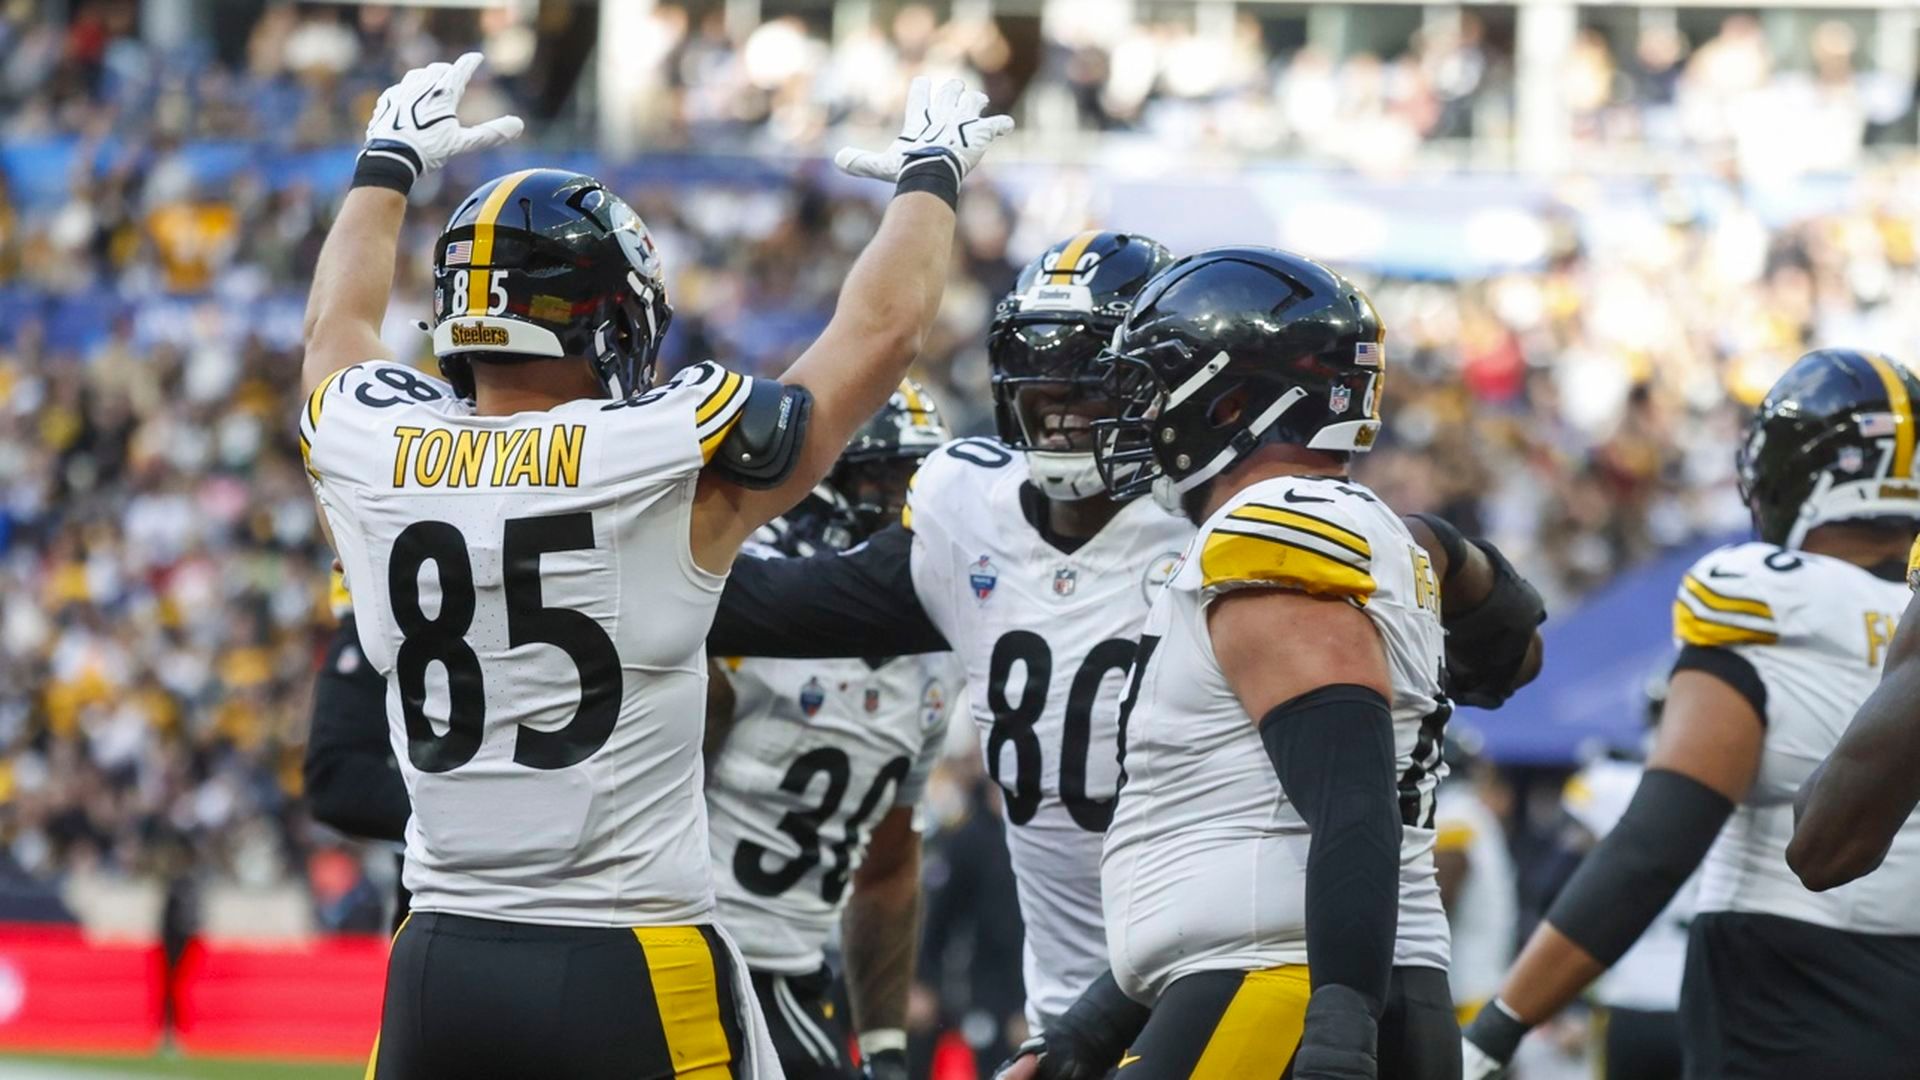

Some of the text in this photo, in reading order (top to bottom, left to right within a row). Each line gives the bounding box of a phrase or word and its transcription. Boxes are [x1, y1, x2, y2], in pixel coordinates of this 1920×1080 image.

[452, 269, 509, 316] 85
[451, 321, 510, 346] Steelers
[393, 424, 587, 488] TONYAN
[388, 511, 623, 773] 85
[988, 630, 1138, 833] 80
